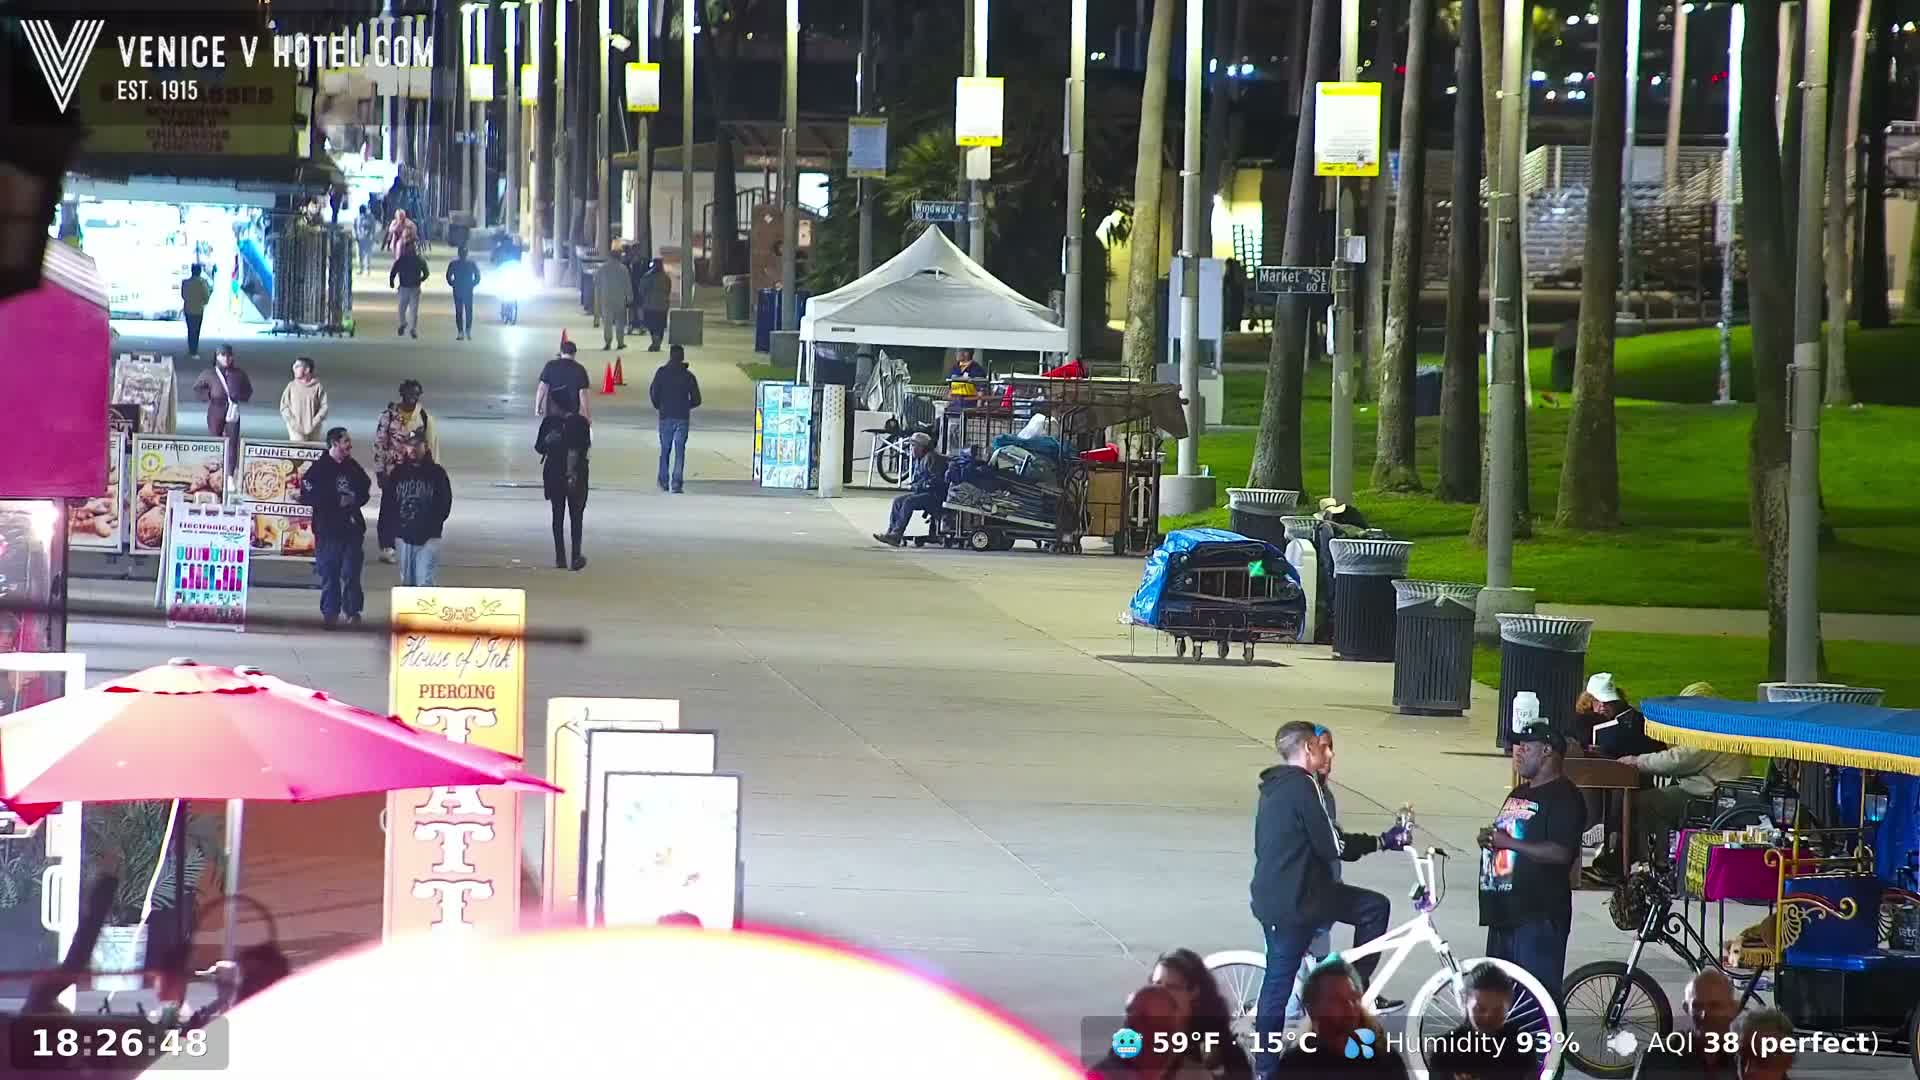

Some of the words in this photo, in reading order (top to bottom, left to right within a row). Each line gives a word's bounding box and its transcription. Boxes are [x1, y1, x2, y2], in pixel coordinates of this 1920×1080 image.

[1259, 269, 1299, 282] Market
[1312, 269, 1327, 283] St
[1320, 282, 1327, 292] E
[141, 442, 163, 450] DEEP
[165, 443, 190, 452] FRIED
[191, 444, 220, 453] OREOS
[248, 447, 292, 457] FUNNEL
[297, 449, 322, 458] CAK
[255, 504, 313, 514] CHURROS
[400, 635, 450, 667] House
[456, 636, 481, 679] of
[477, 635, 513, 668] Ink
[418, 684, 496, 699] PIERCING
